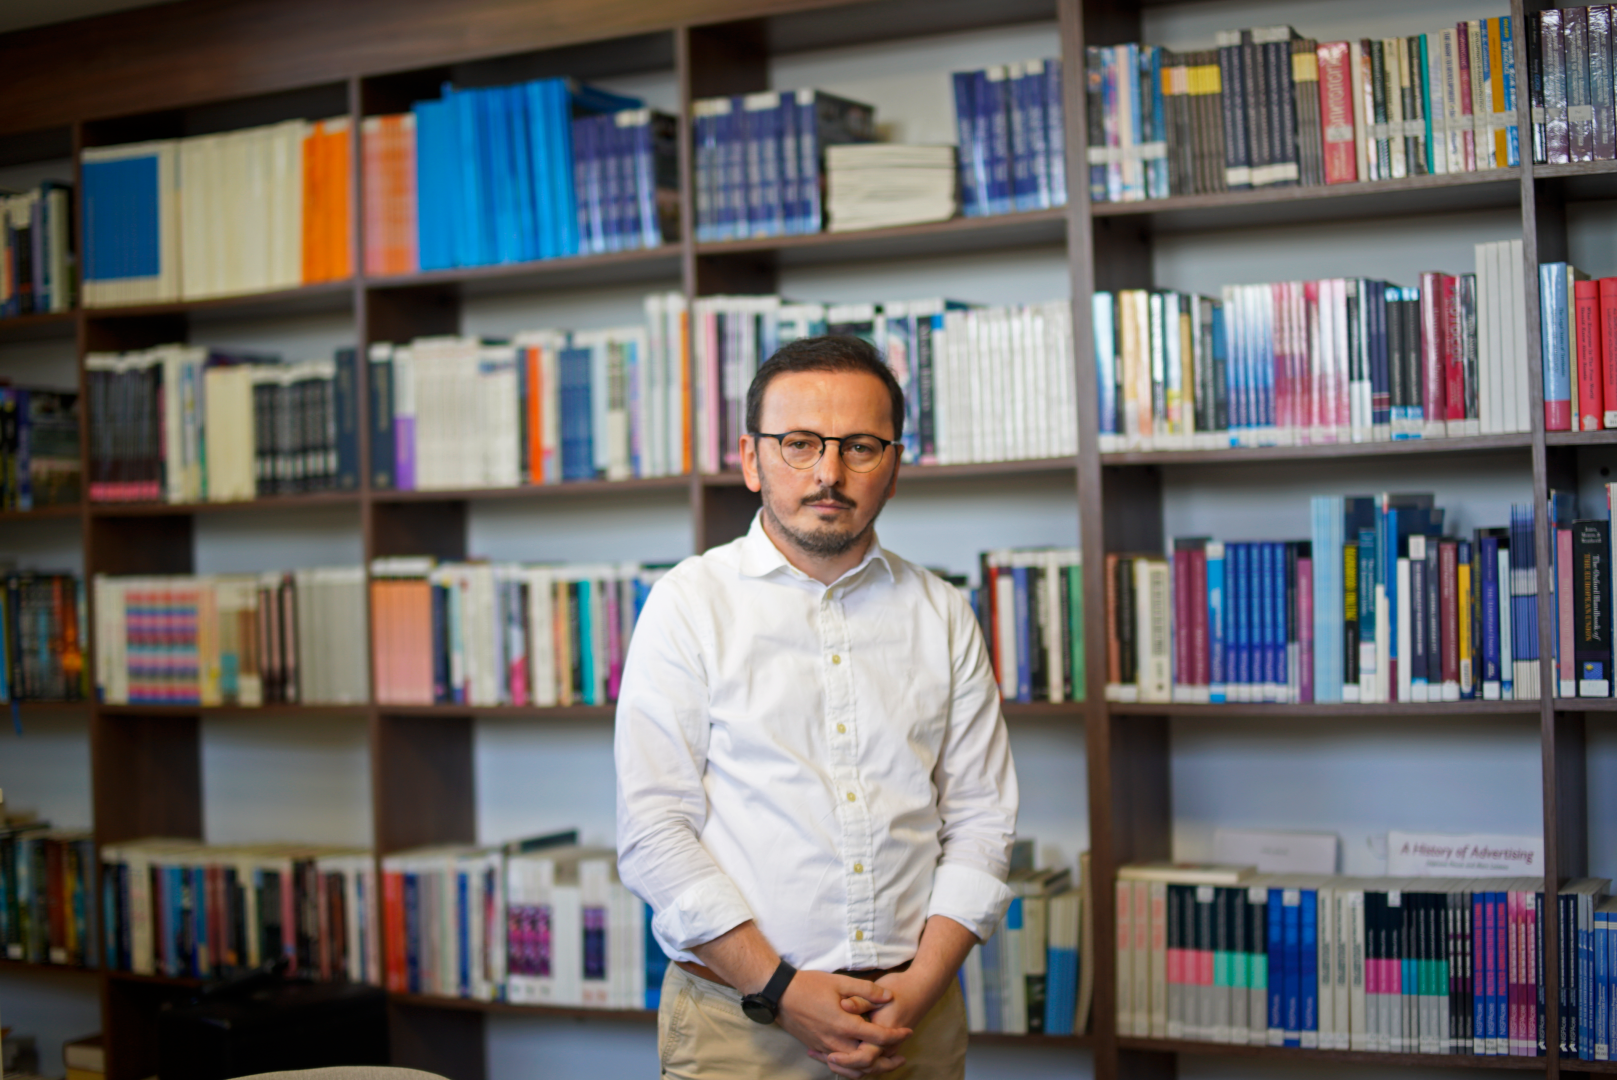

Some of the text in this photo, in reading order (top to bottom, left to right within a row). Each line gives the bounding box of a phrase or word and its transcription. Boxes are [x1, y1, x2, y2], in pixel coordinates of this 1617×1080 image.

[1449, 286, 1462, 367] PROTOCOL
[1584, 554, 1592, 570] THE
[1584, 570, 1592, 615] EUROPEAN
[1593, 595, 1601, 630] Handbook
[1593, 630, 1602, 641] of
[1401, 842, 1409, 854] A
[1413, 843, 1453, 859] History
[1455, 844, 1469, 859] of
[1471, 845, 1534, 865] Advertising
[1486, 903, 1494, 927] DILEMMA
